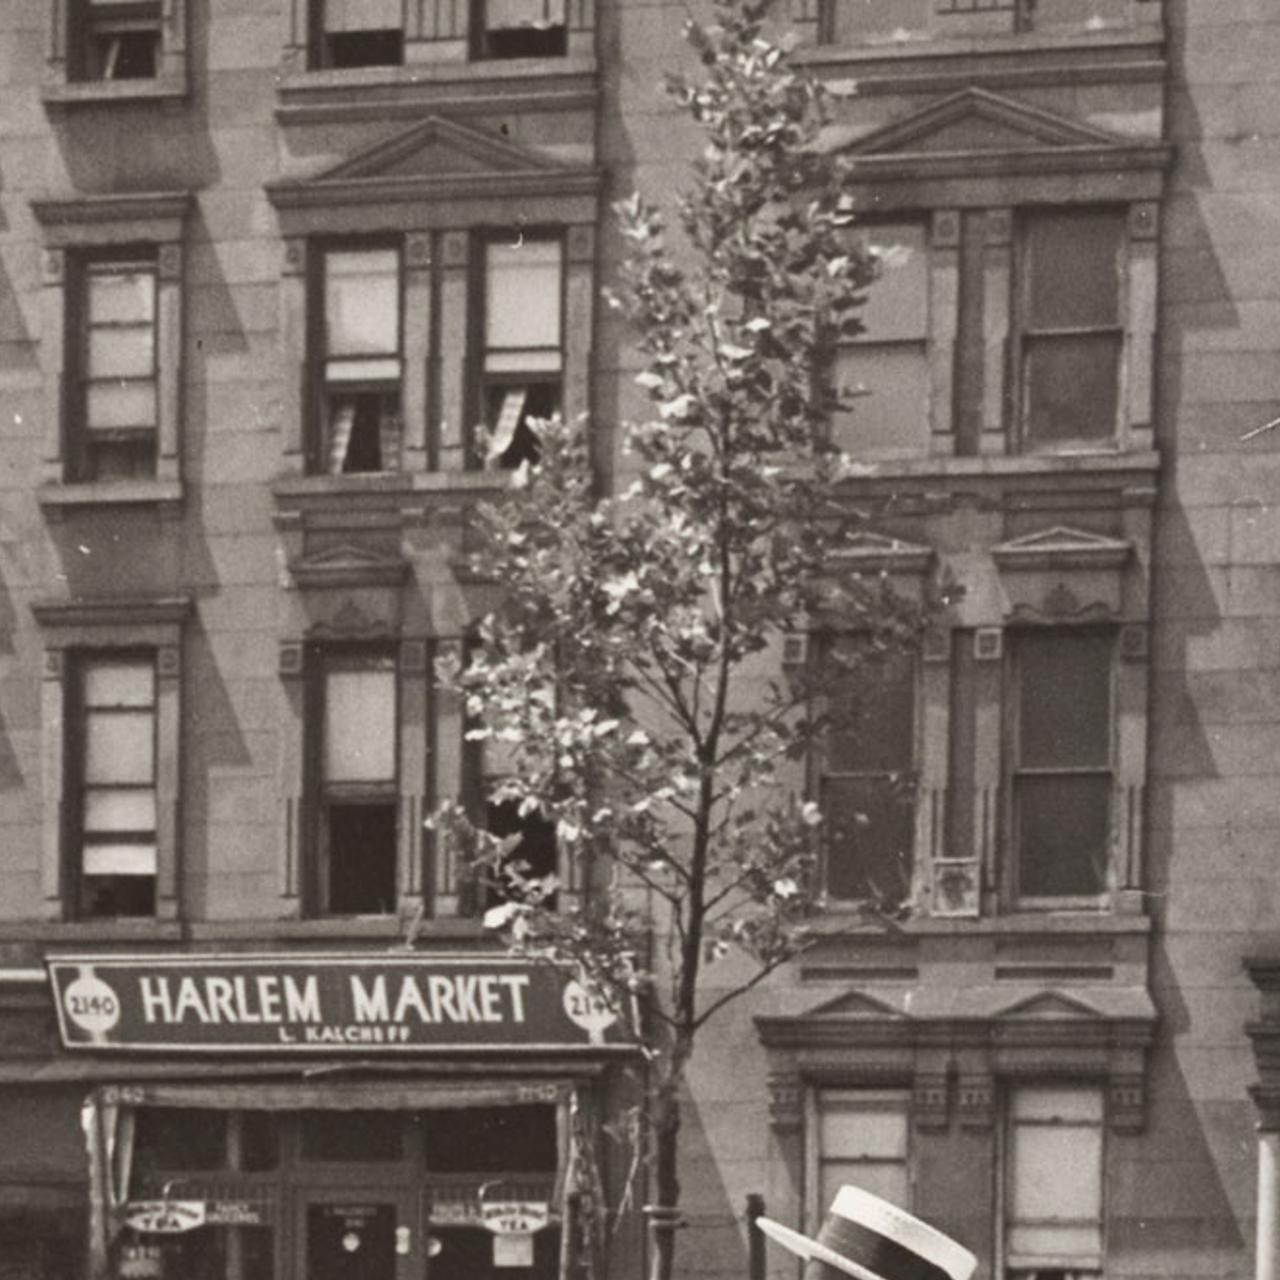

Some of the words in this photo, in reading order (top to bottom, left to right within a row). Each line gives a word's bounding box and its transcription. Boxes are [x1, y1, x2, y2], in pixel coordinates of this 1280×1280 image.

[69, 995, 115, 1016] 2140
[139, 975, 321, 1024] HARLEM
[351, 973, 530, 1023] MARKET
[569, 994, 619, 1016] 214
